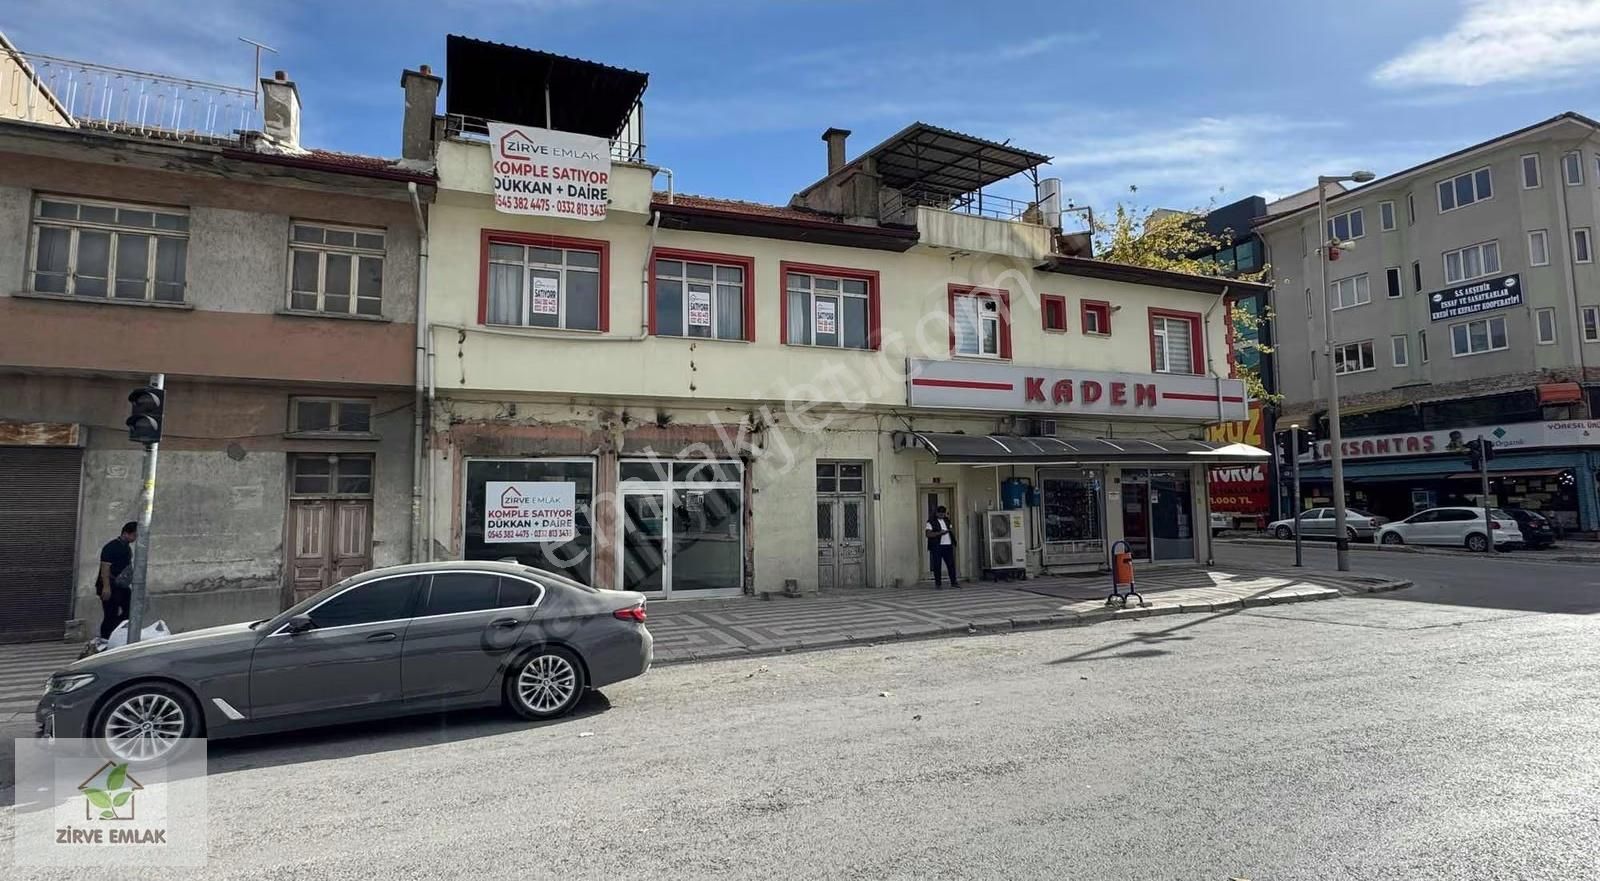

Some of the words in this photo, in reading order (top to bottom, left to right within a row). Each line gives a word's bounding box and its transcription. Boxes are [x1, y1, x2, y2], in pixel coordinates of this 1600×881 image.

[507, 141, 548, 155] ZİRVE
[552, 147, 600, 160] EMLAK
[552, 166, 608, 185] SATIYOR
[556, 185, 564, 194] +
[567, 183, 608, 201] DAİRE
[514, 196, 529, 210] 382
[530, 198, 550, 212] 4475
[557, 200, 575, 213] 0332
[577, 202, 588, 216] 813
[1459, 297, 1467, 305] VE
[1449, 308, 1457, 316] VE
[1024, 376, 1157, 408] KADEM
[504, 496, 530, 504] ZİRVE
[488, 509, 529, 518] KOMPLE
[532, 509, 573, 518] SATIYOR
[488, 518, 532, 528] DÜKKAN
[542, 517, 573, 528] DAİRE
